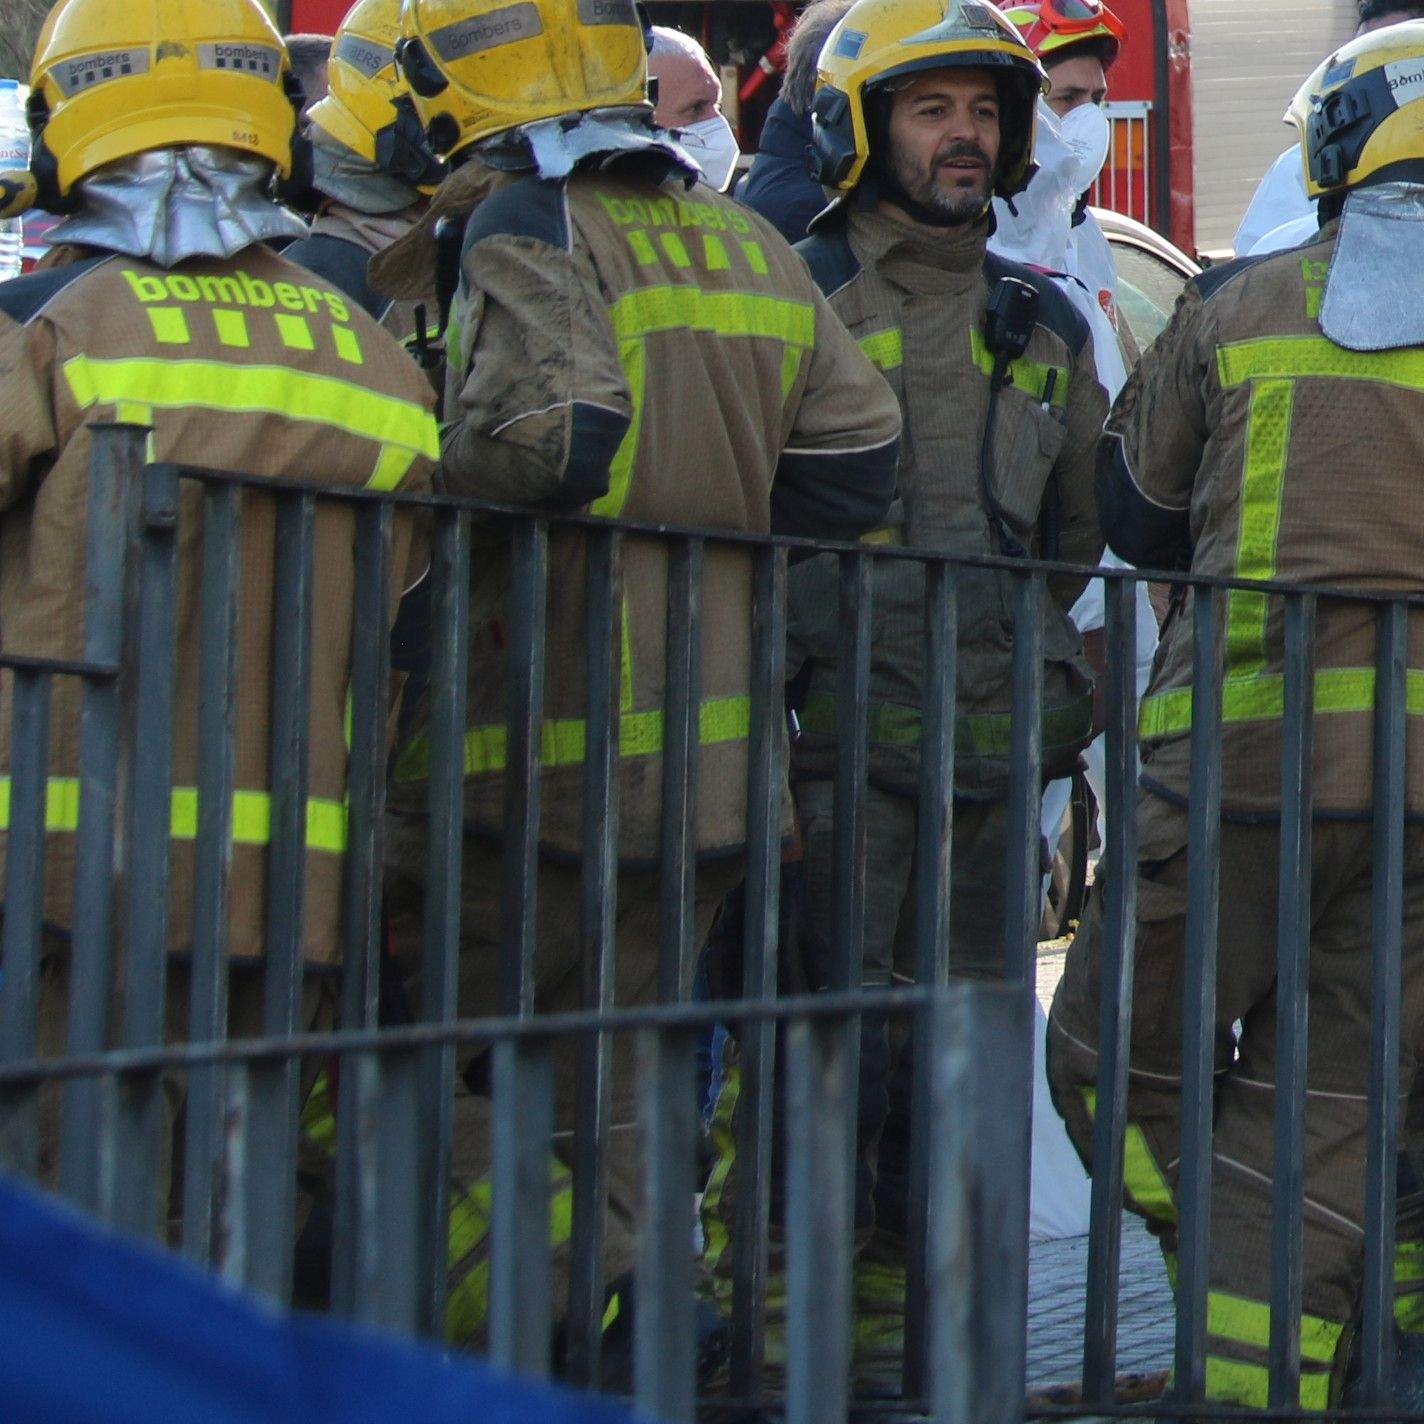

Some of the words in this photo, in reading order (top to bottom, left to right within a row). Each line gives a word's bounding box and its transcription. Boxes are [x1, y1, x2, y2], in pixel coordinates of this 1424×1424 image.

[449, 18, 522, 50] Bombers
[69, 52, 130, 75] bombers
[214, 43, 269, 62] bombers
[120, 269, 350, 322] bombers
